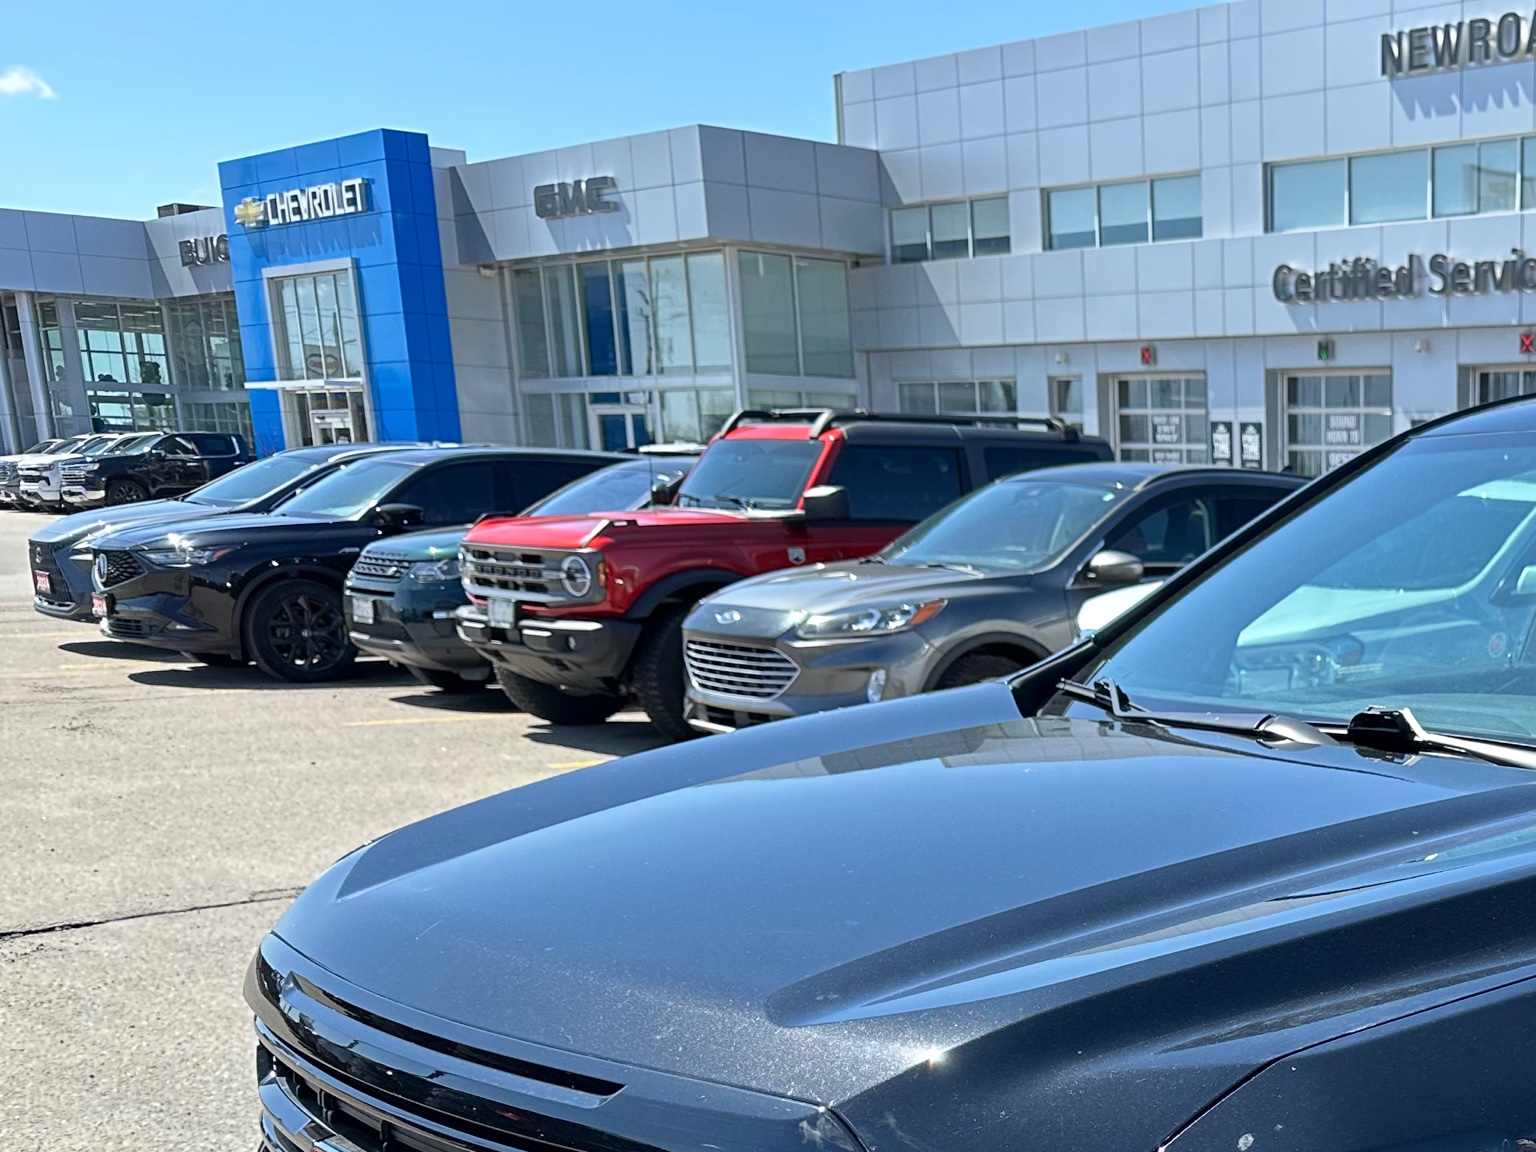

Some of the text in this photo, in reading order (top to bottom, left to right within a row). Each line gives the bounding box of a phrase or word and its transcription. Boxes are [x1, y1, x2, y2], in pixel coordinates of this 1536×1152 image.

[266, 177, 364, 226] CHEVROLET
[533, 176, 619, 219] GMC
[178, 233, 230, 267] BUIC
[1272, 252, 1417, 303] Certified
